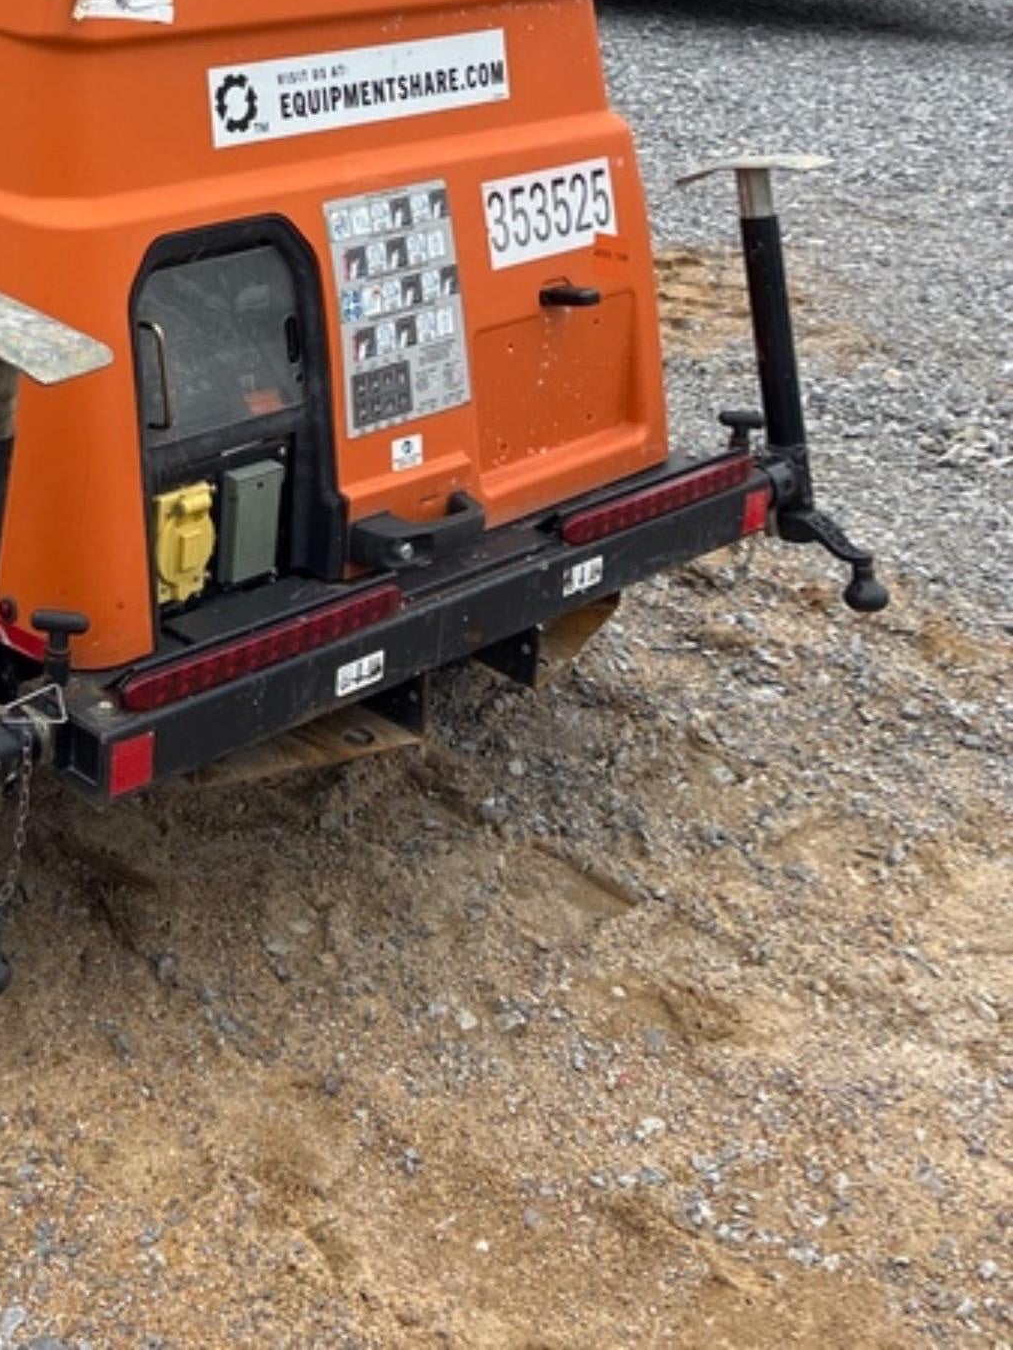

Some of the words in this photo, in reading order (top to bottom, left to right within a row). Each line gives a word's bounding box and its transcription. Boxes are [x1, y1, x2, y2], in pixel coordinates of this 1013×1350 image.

[277, 69, 308, 84] VISIT
[311, 66, 327, 81] US
[280, 60, 504, 119] EQUIPMENTSHARE.COM
[488, 168, 611, 252] 353525
